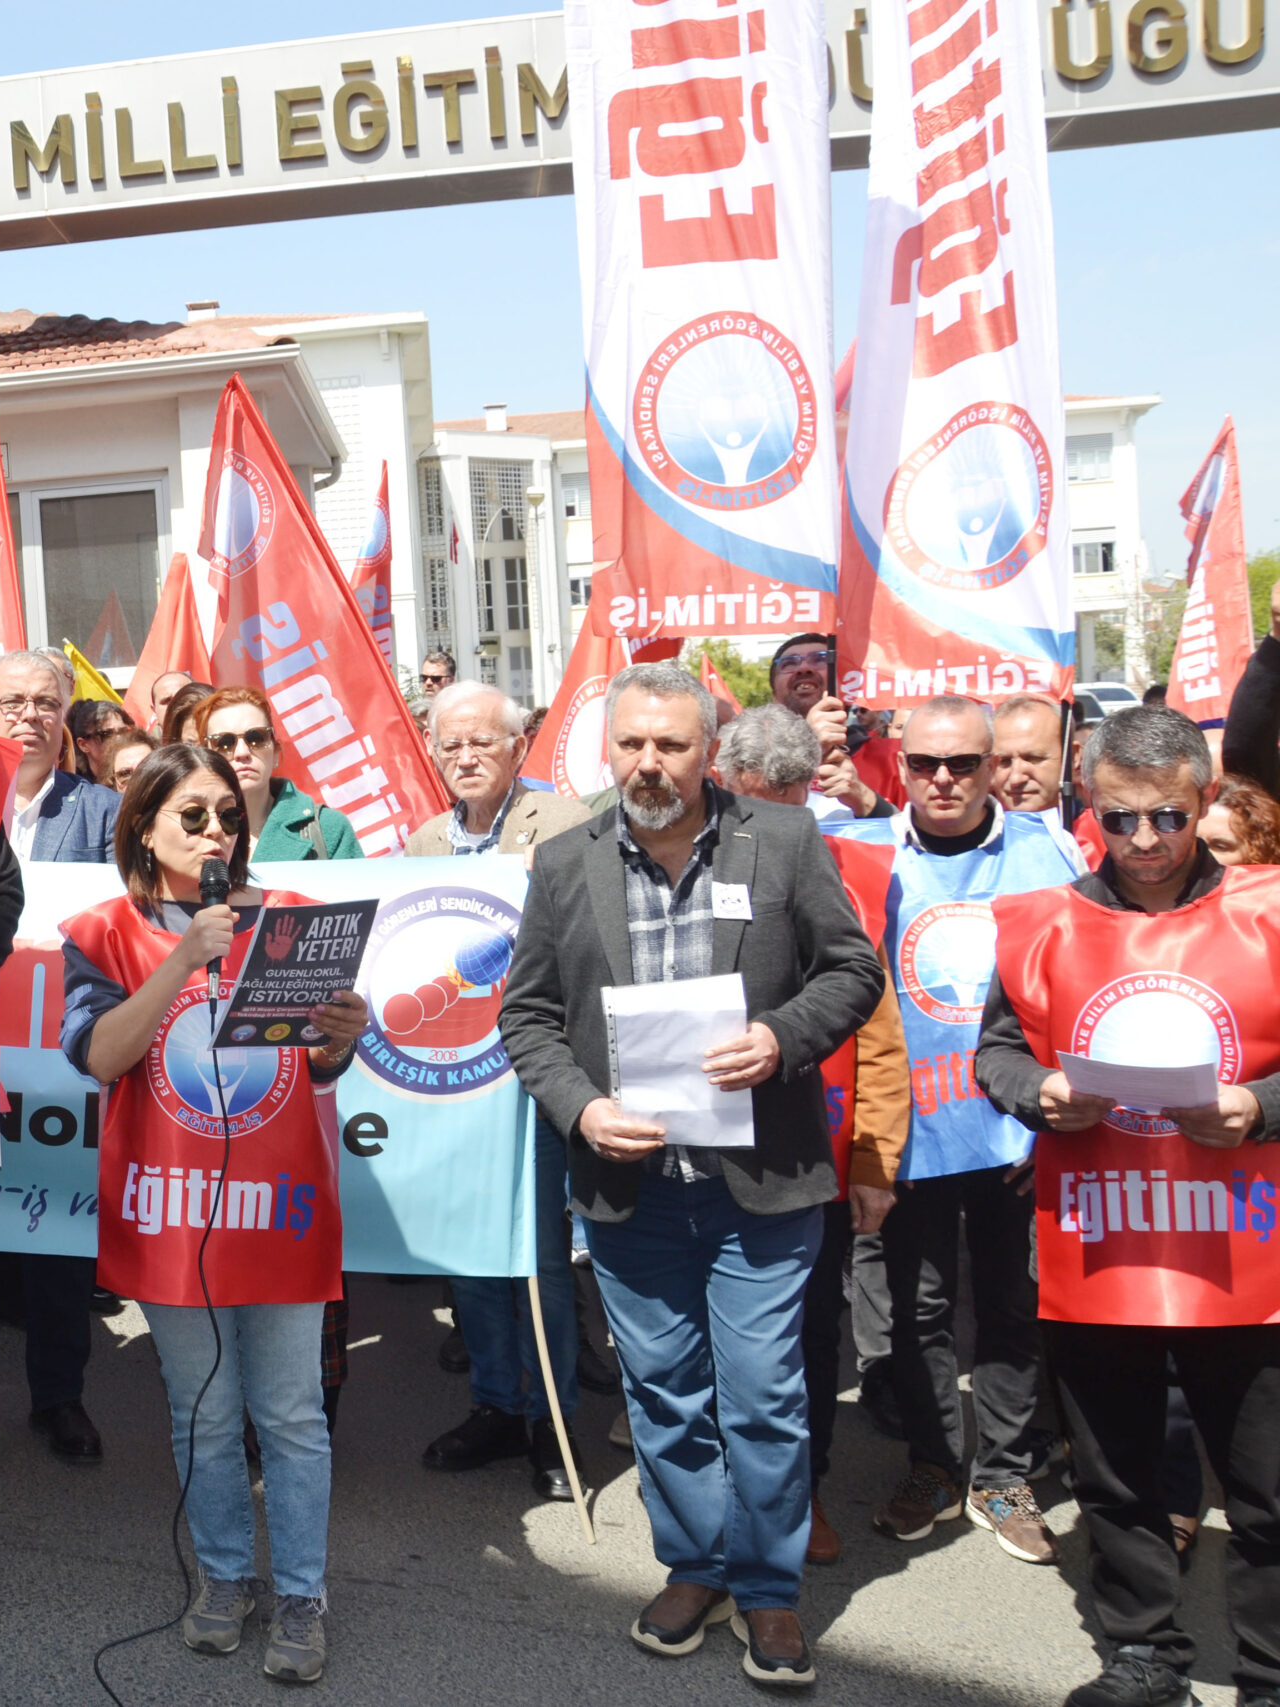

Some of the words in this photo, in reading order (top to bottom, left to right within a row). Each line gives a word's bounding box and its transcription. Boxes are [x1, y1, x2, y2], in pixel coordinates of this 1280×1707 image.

[10, 76, 242, 190] MİLLİ
[274, 46, 568, 161] EĞİTİM
[305, 912, 363, 939] ARTIK
[906, 912, 935, 942] BİLİM
[296, 935, 361, 962] YETER!
[904, 943, 913, 959] VE
[285, 978, 324, 989] EĞİTİM
[313, 967, 345, 978] OKUL,
[1077, 1028, 1090, 1046] VE
[1084, 990, 1118, 1026] BİLİM
[1117, 974, 1221, 1015] İŞGÖRENLERİ
[149, 1047, 171, 1097] EĞİTİM
[161, 995, 192, 1026] BİLİM
[360, 1031, 440, 1087] BİRLEŞİK
[428, 1049, 459, 1062] 2008
[176, 1107, 262, 1134] EĞİTİM-İŞ
